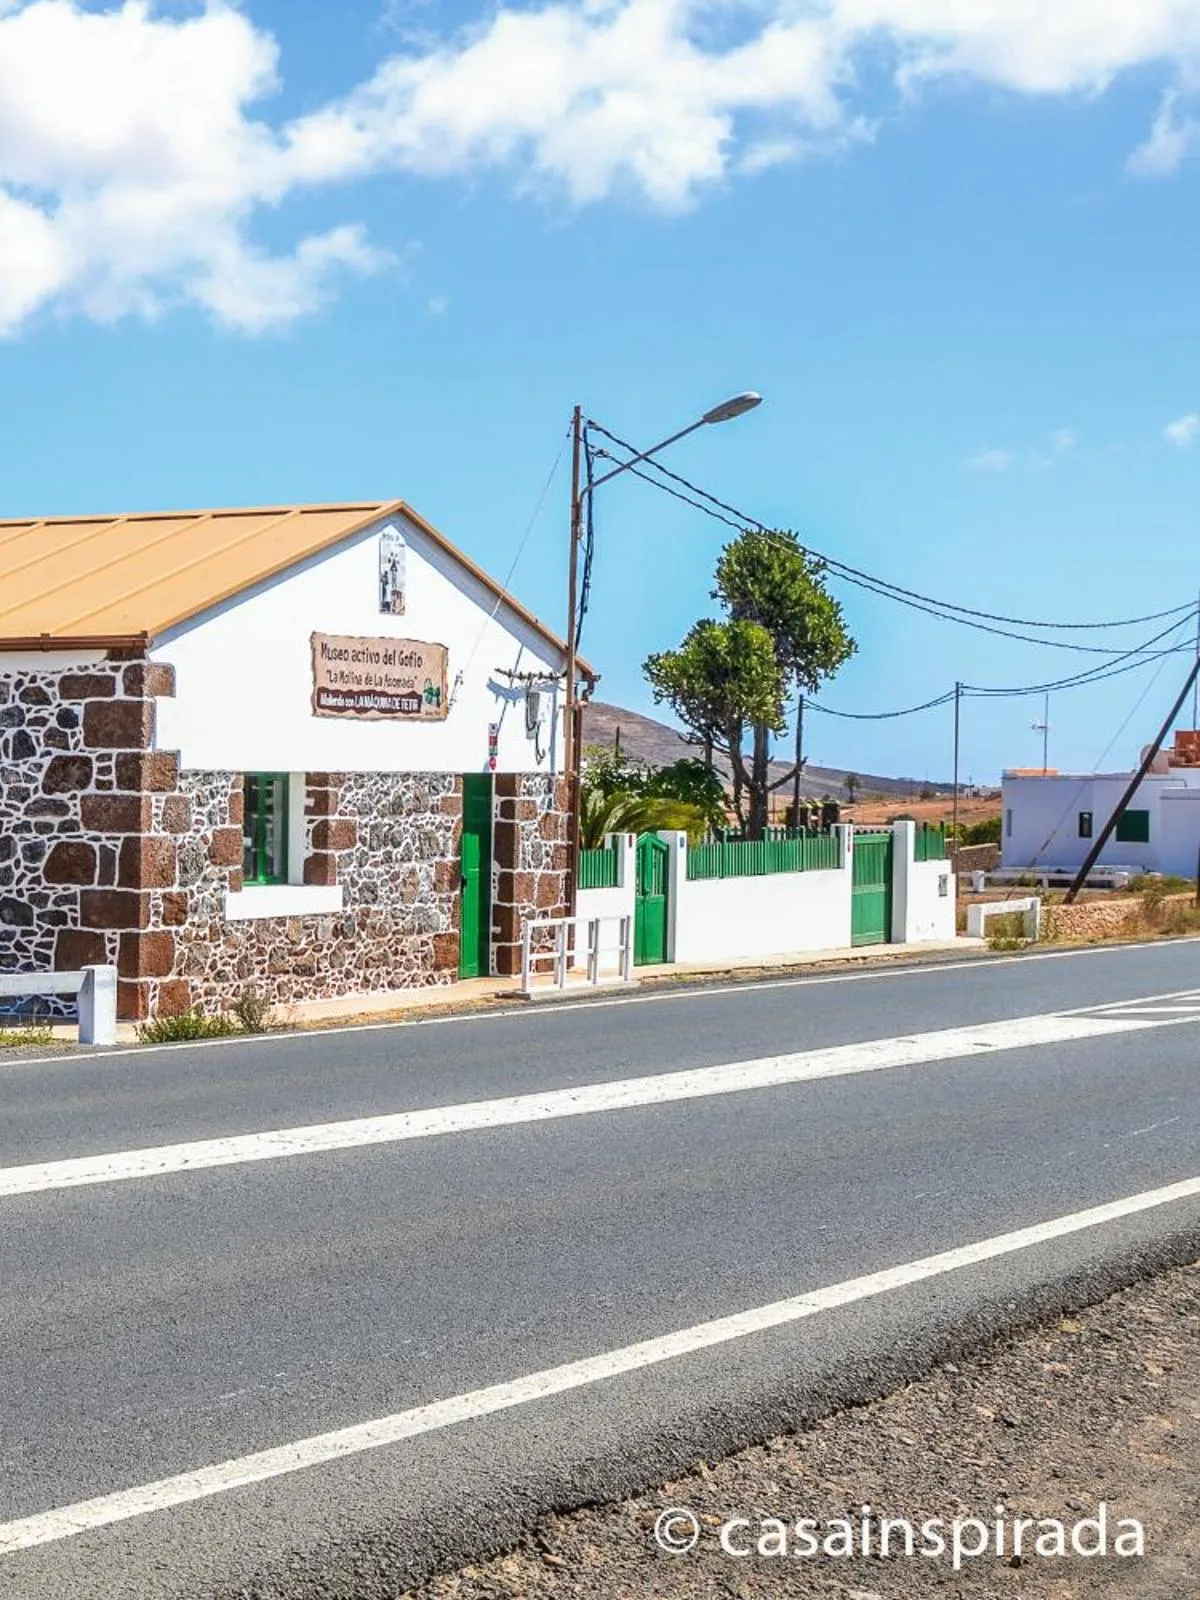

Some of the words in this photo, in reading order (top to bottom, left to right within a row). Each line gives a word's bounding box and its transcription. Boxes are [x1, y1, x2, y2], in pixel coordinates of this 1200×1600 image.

[321, 642, 349, 662] Museo
[351, 647, 380, 665] activo
[382, 649, 396, 666] del
[399, 650, 424, 668] Gofio
[339, 670, 363, 685] Molina
[364, 672, 373, 686] de
[374, 673, 382, 687] La
